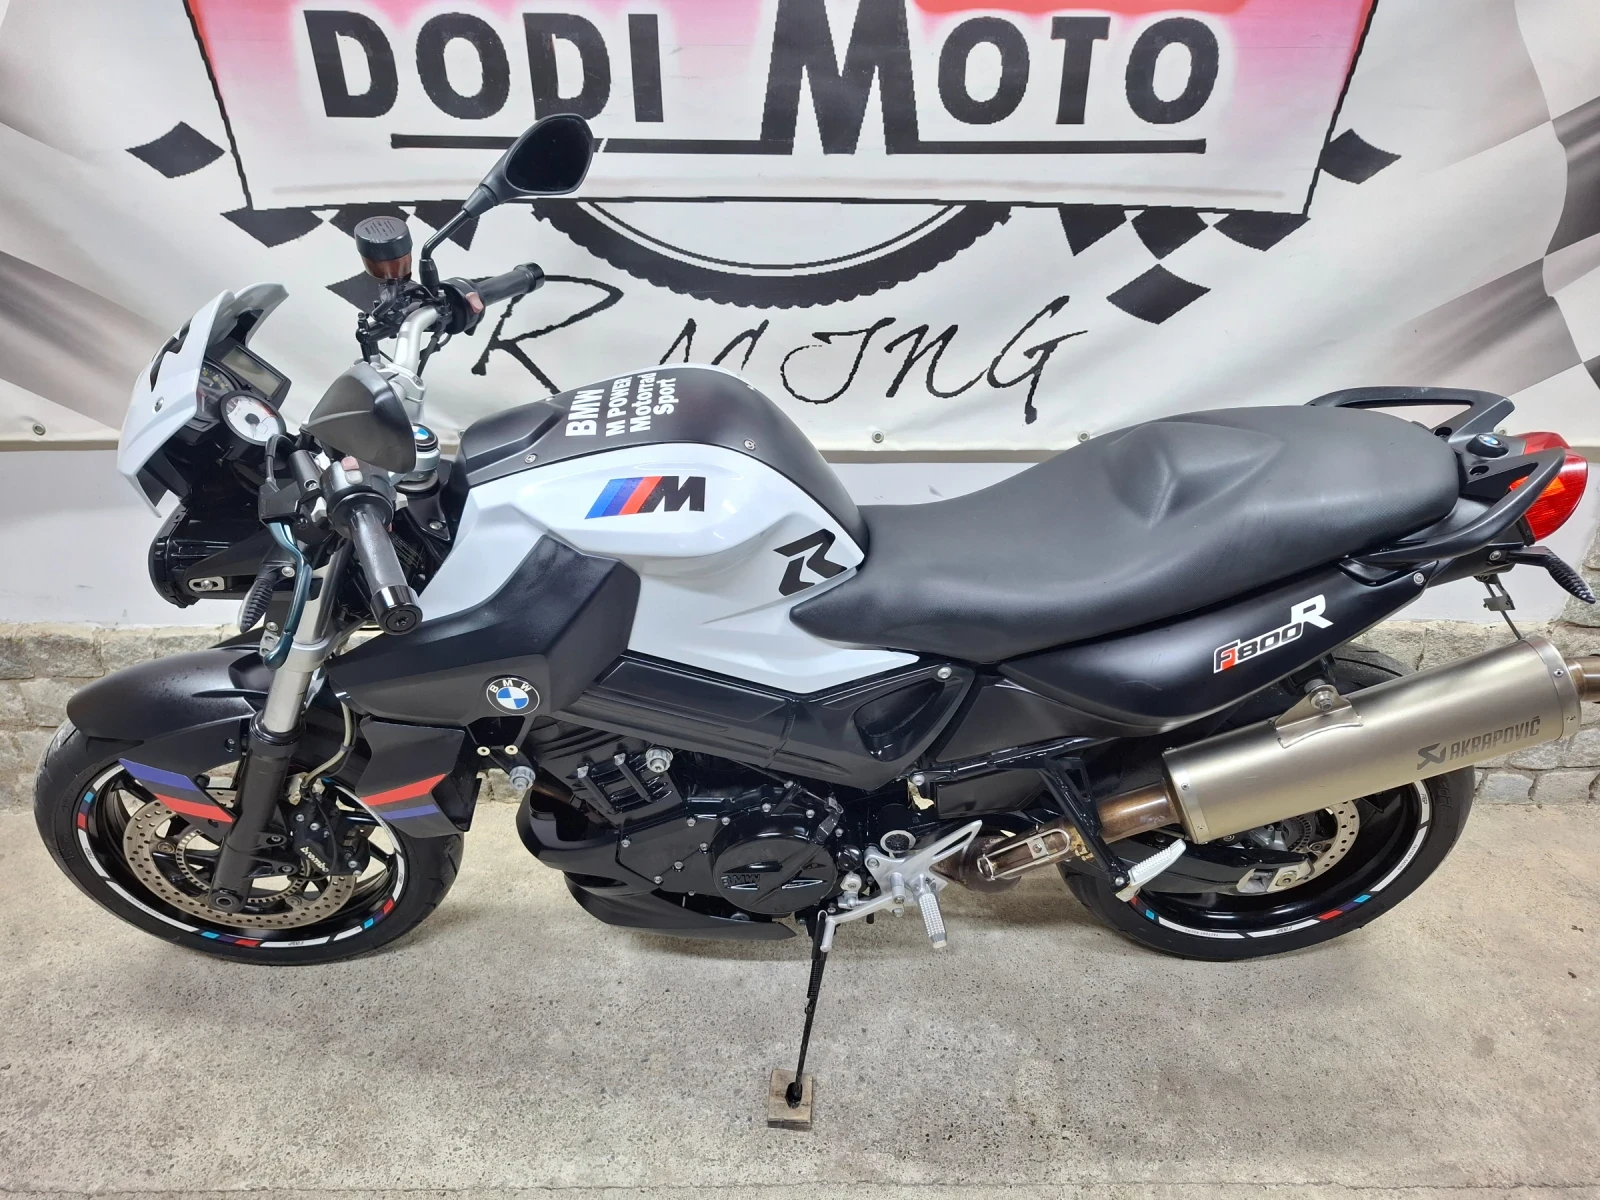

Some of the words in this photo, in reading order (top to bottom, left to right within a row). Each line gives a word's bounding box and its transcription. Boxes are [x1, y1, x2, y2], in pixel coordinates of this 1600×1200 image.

[303, 10, 663, 122] DODI
[565, 388, 605, 437] BMW
[607, 376, 632, 419] POWER
[629, 372, 657, 433] Motorrad
[653, 378, 679, 415] Sport
[605, 419, 626, 437] M
[489, 679, 532, 693] BMW
[300, 846, 330, 872] brembo
[721, 873, 761, 886] BMW
